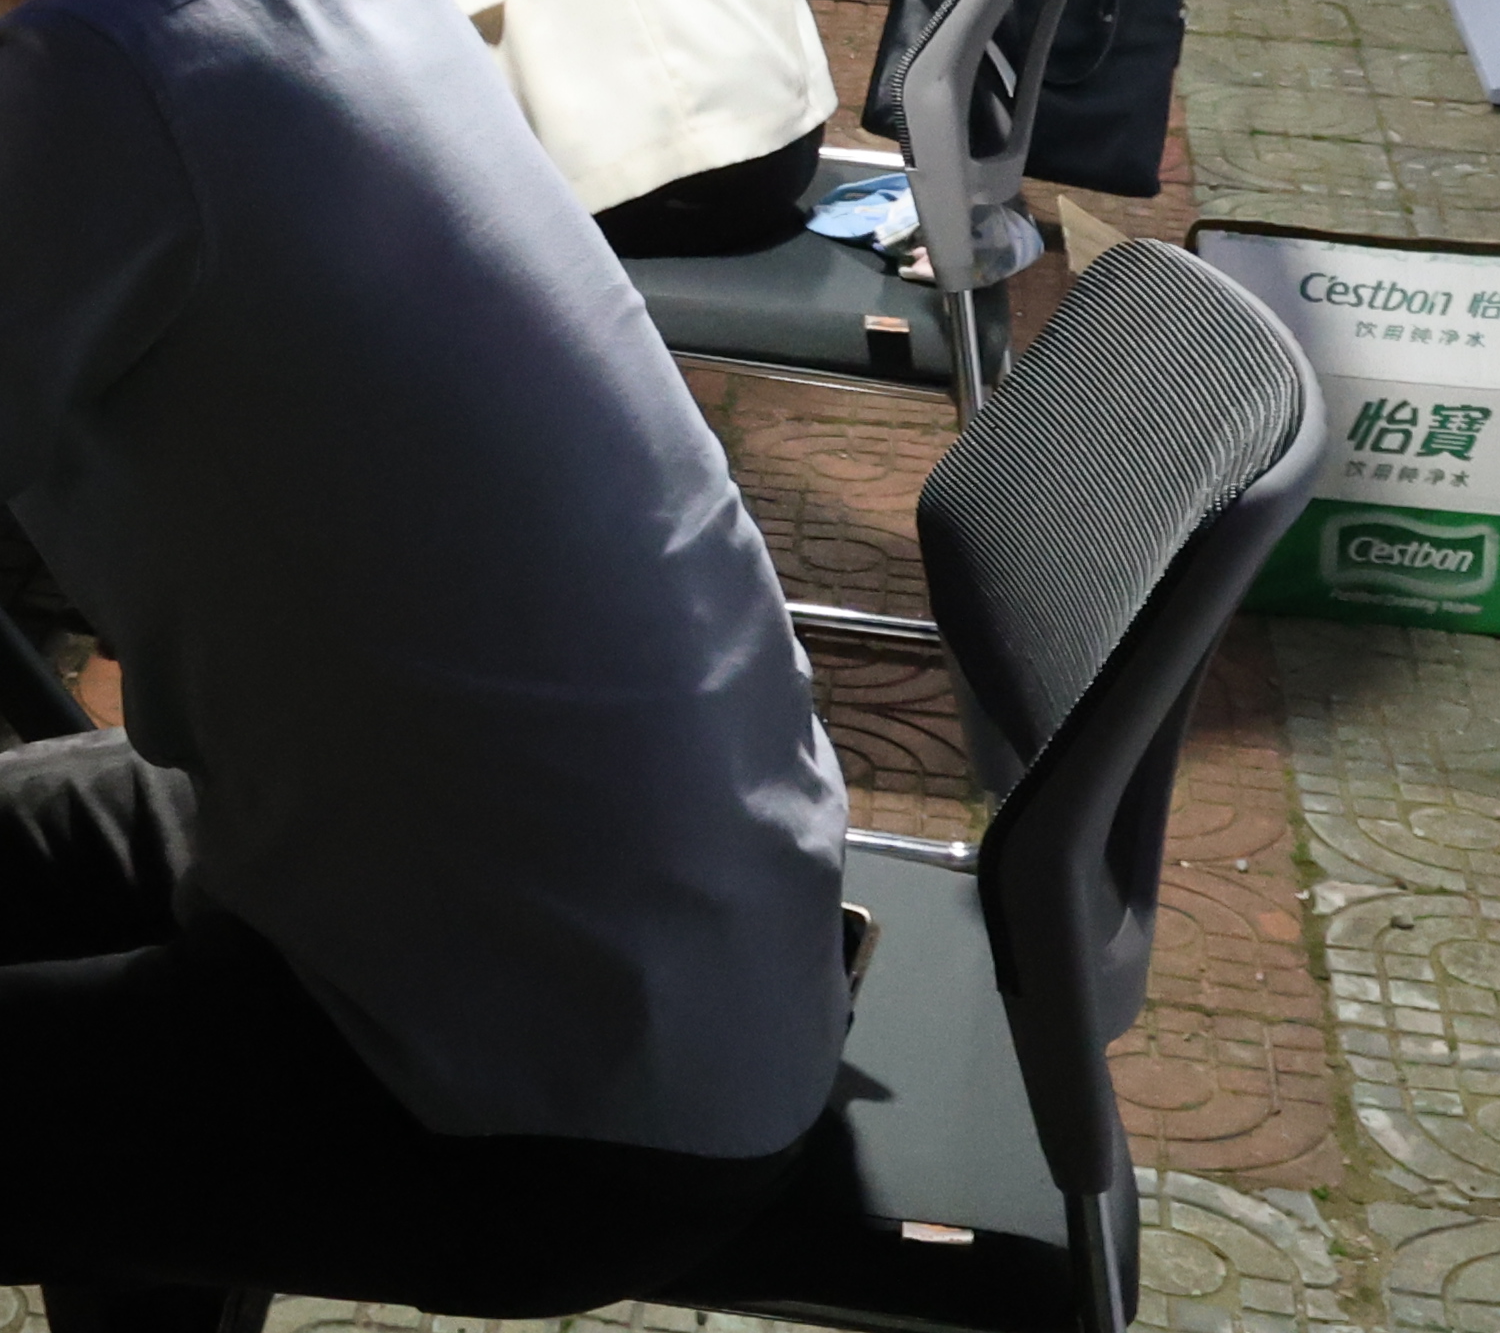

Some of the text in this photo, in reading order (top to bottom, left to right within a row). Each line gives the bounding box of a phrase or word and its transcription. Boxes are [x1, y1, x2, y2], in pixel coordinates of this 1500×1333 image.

[1354, 320, 1487, 349] 饮用纯净水
